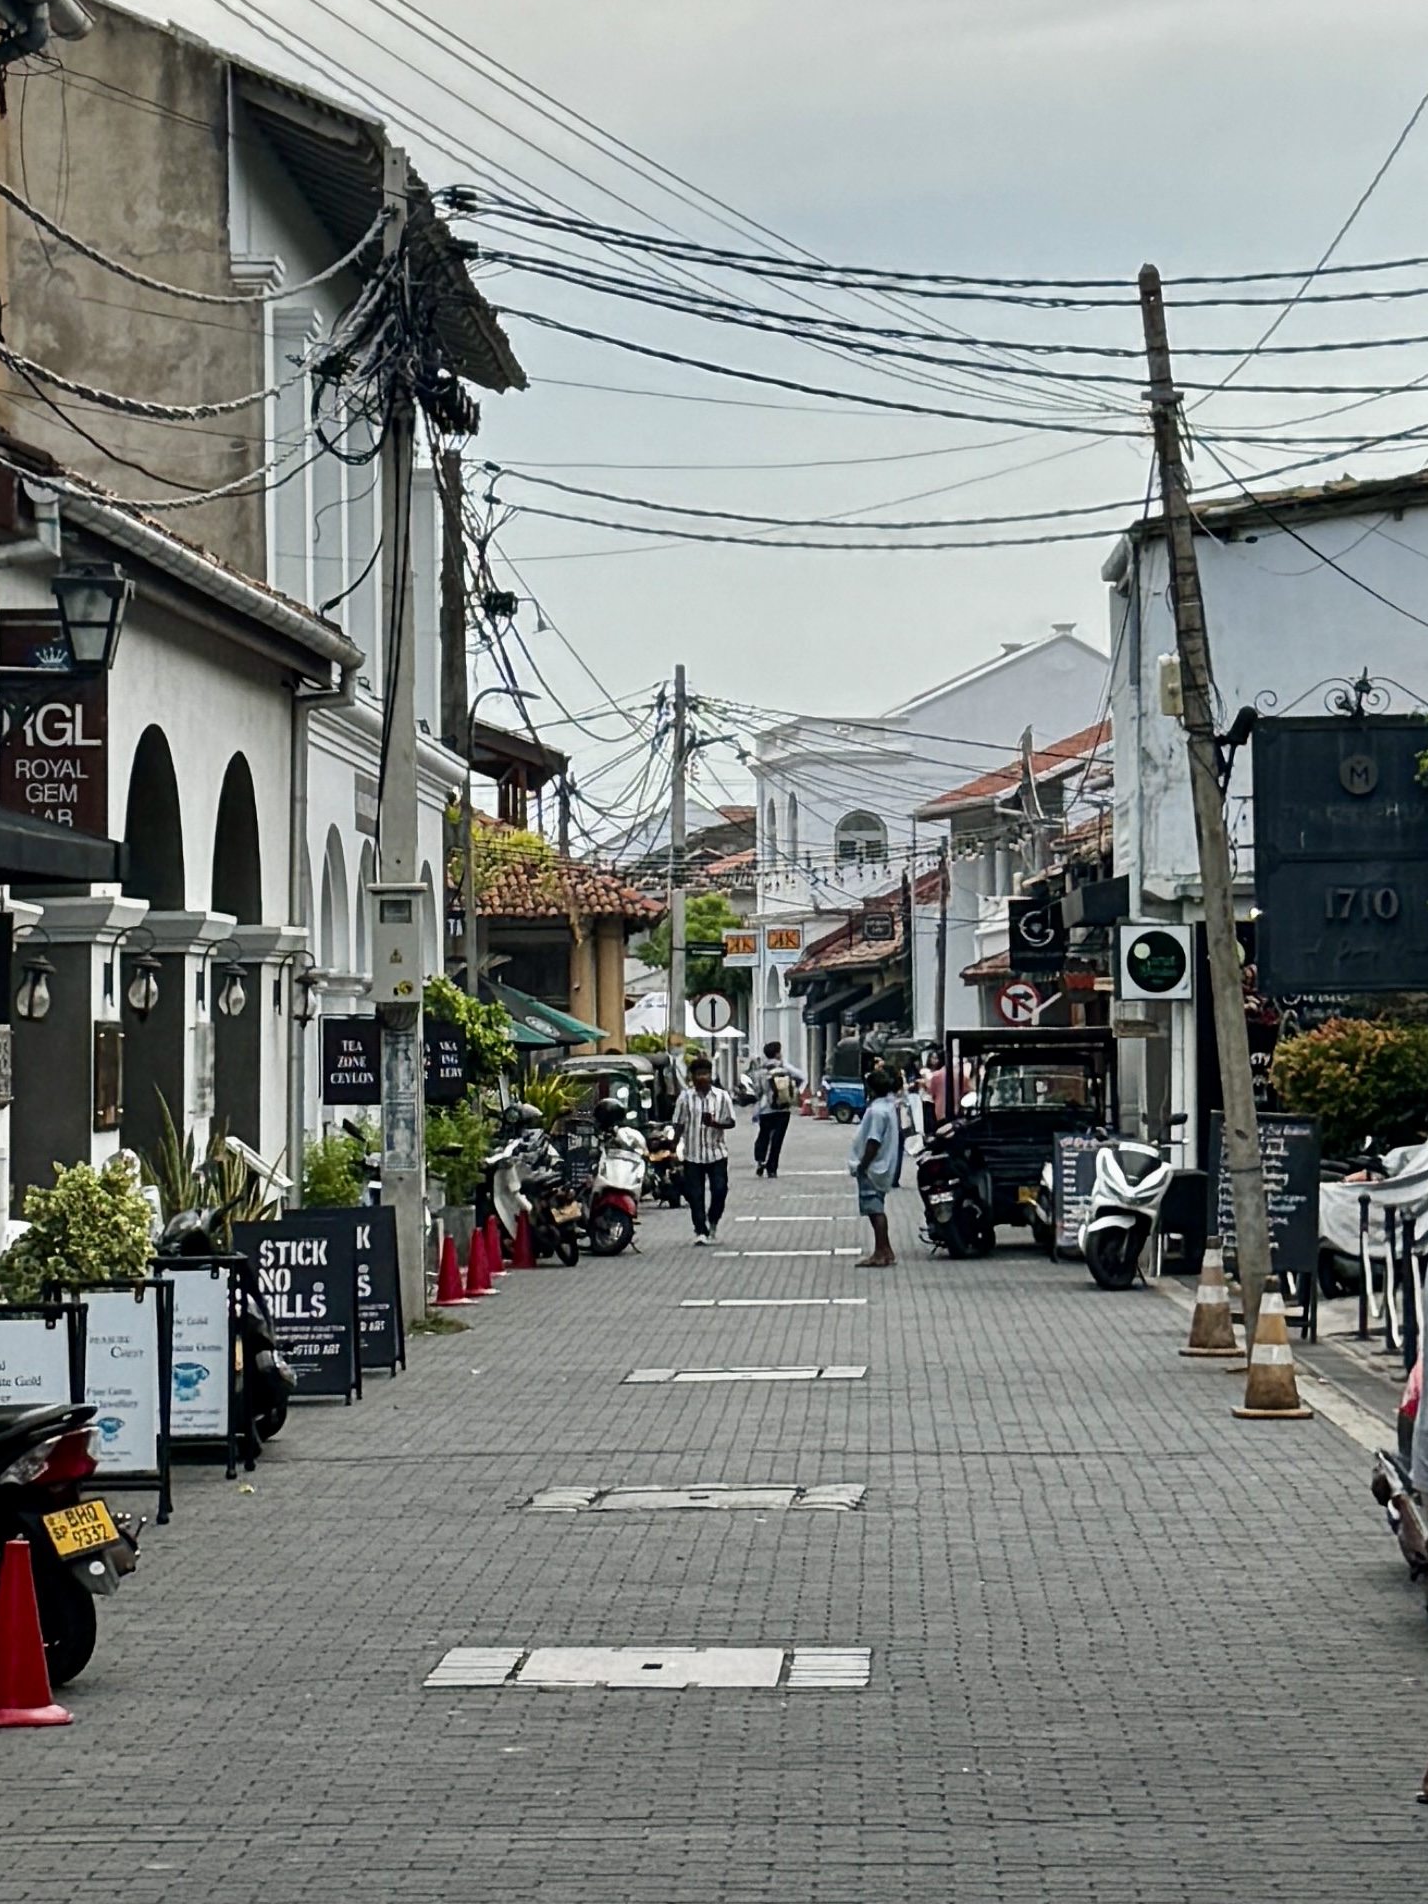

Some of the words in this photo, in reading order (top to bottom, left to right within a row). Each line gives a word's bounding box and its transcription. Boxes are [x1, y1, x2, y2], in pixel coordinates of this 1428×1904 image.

[15, 758, 89, 779] ROYAL
[25, 782, 78, 804] GEM
[1325, 886, 1400, 920] 1710
[341, 1040, 363, 1052] TEA
[336, 1055, 367, 1068] ZONE
[330, 1072, 374, 1084] CEYLON
[259, 1239, 328, 1266] STICK
[258, 1268, 291, 1293] NO
[15, 1375, 42, 1387] Gold
